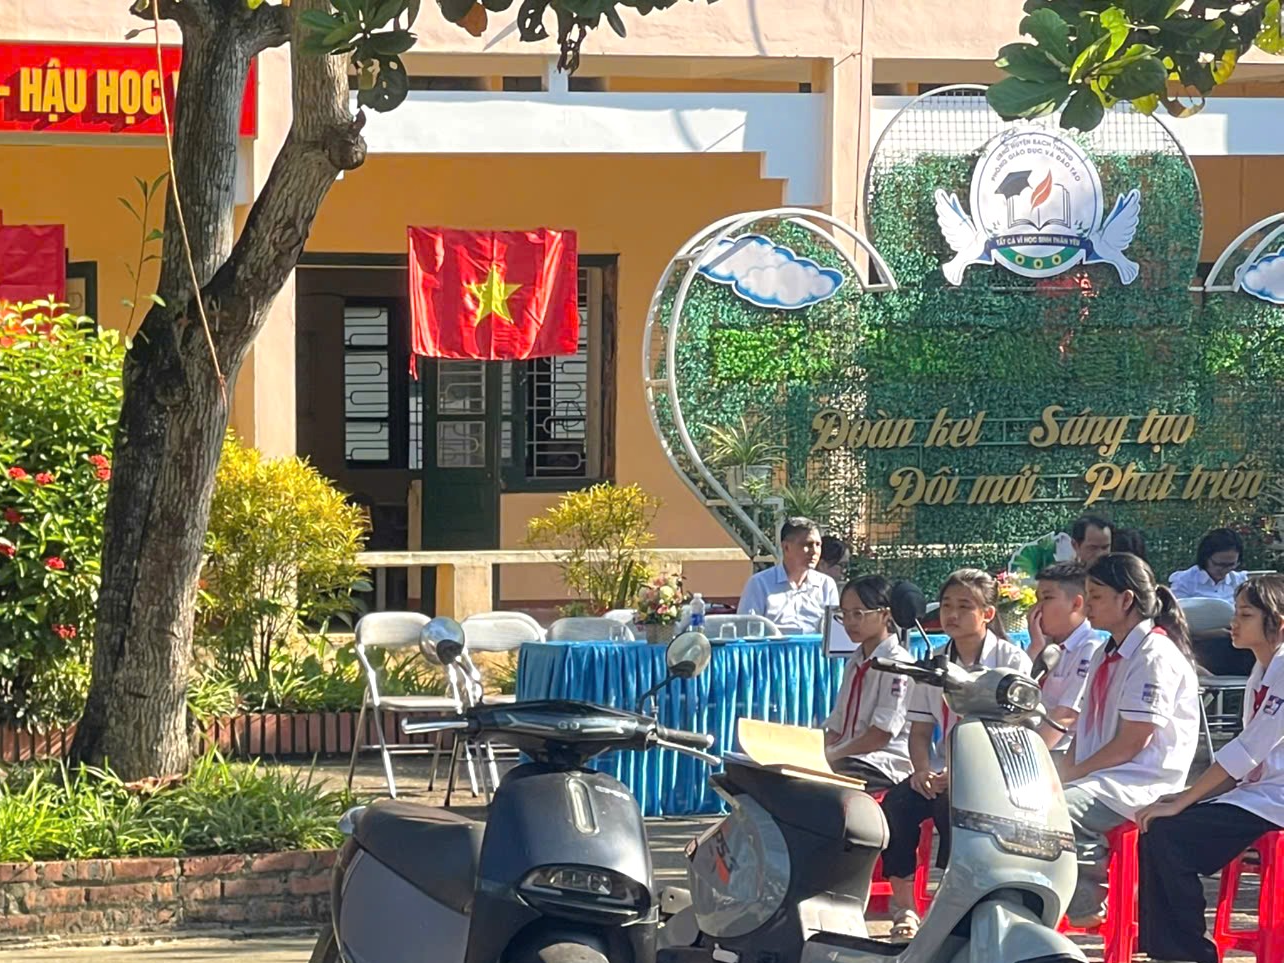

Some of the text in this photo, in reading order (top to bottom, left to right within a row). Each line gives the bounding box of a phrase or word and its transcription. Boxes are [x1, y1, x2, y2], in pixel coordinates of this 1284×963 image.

[20, 58, 87, 122] HẬU
[96, 69, 162, 124] HỌC
[1029, 405, 1195, 456] Sáng tạo
[967, 464, 1040, 504] mới
